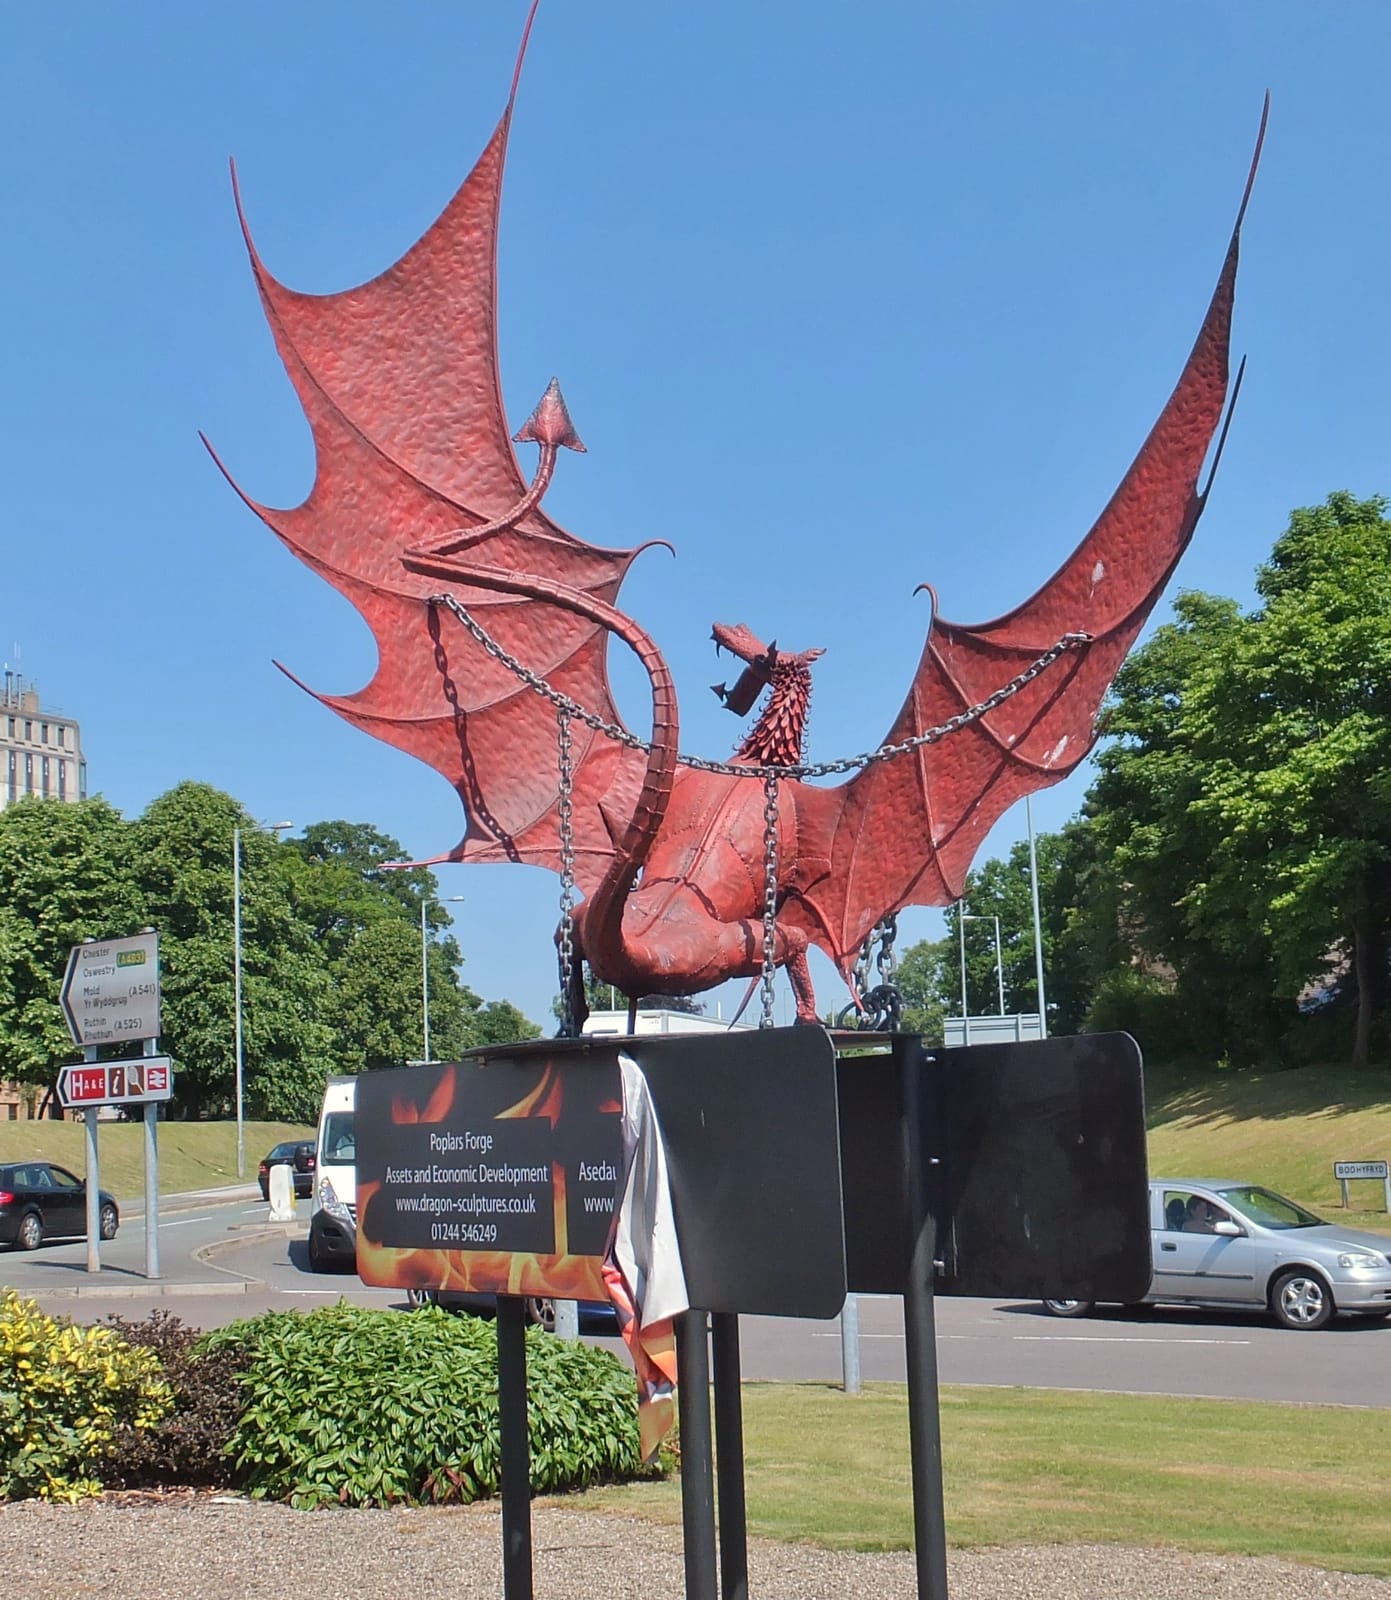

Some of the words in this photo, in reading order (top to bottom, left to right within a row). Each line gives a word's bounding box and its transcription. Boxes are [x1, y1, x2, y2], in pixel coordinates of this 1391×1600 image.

[82, 948, 110, 959] Chester
[83, 966, 116, 978] Oswestry
[84, 986, 100, 996] Mold
[84, 1018, 107, 1028] Ruthin
[430, 1131, 464, 1155] Poplars
[465, 1131, 493, 1154] Forge
[385, 1166, 413, 1183] Assets
[414, 1164, 431, 1183] and
[433, 1164, 478, 1183] Economic
[480, 1162, 548, 1187] Development
[1338, 1165, 1384, 1174] BODHYFRYD
[396, 1193, 536, 1217] www.dragon-sculptures.co.uk
[431, 1223, 459, 1241] 01244
[461, 1223, 497, 1243] 546249
